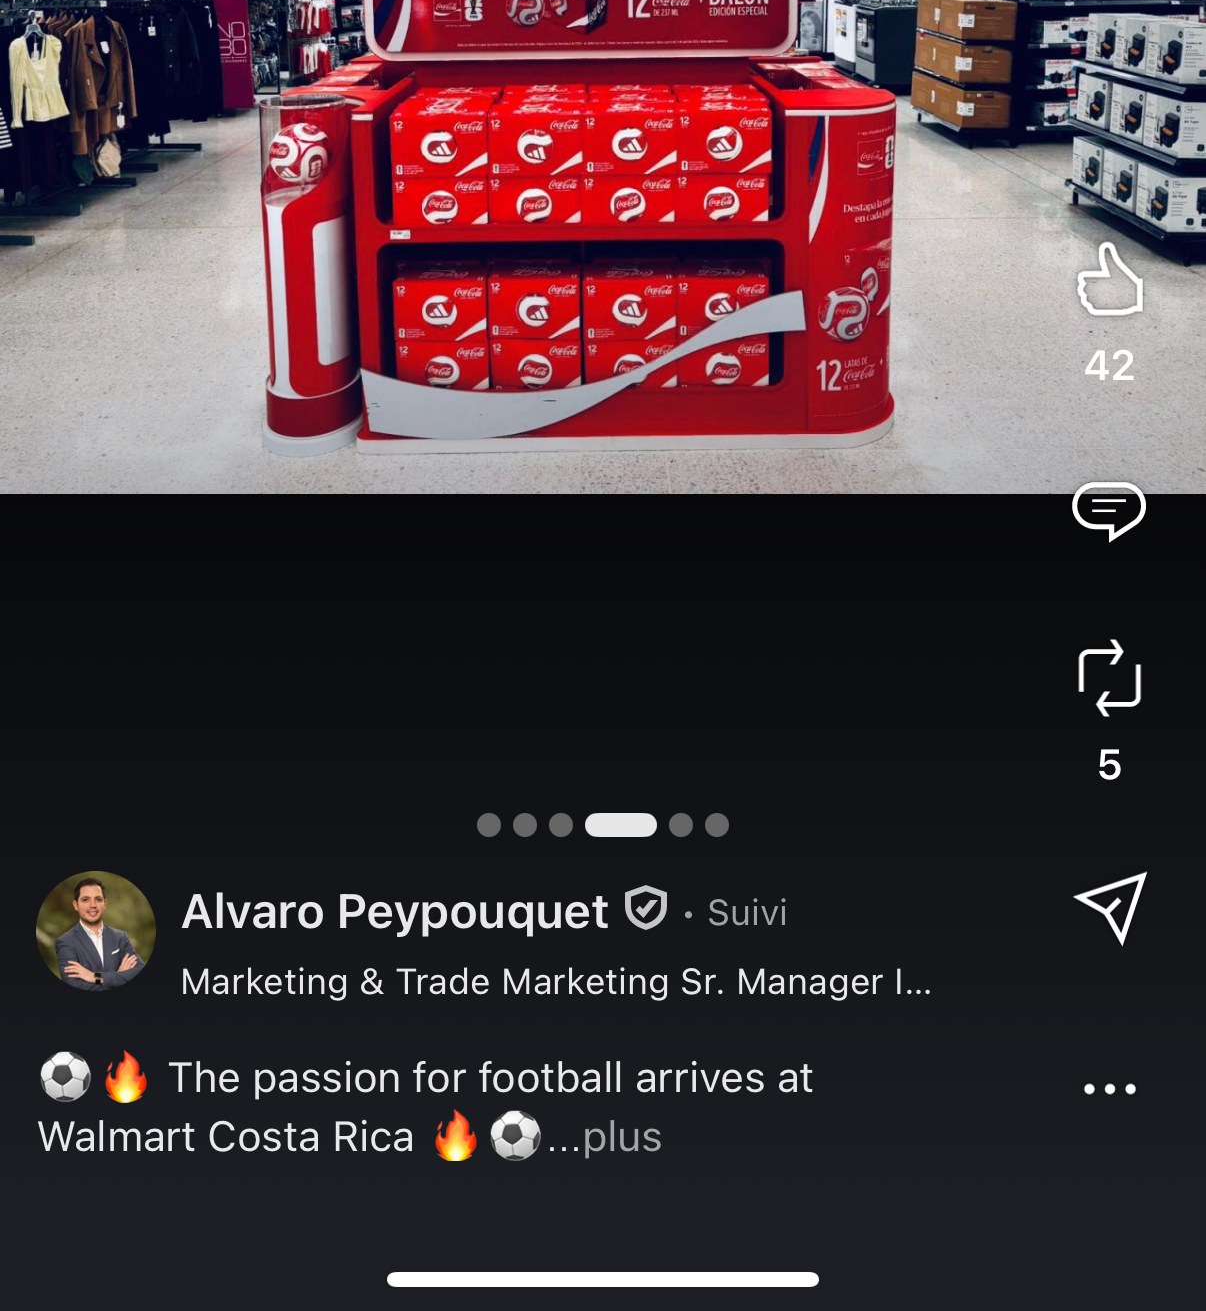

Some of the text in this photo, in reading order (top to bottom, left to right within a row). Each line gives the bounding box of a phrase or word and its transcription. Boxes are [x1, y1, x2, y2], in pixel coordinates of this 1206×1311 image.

[709, 6, 768, 17] EDICIÓN ESPECIAL
[393, 120, 404, 129] 12
[490, 119, 500, 128] 12
[585, 117, 595, 126] 12
[680, 116, 690, 125] 12
[490, 179, 500, 188] 12
[584, 178, 594, 186] 12
[677, 176, 687, 185] 12
[395, 182, 405, 191] 12
[396, 285, 406, 294] 12
[490, 282, 500, 291] 12
[586, 285, 596, 293] 12
[679, 282, 688, 291] 12
[399, 345, 408, 354] 12
[492, 343, 502, 352] 12
[588, 344, 597, 353] 12
[816, 359, 842, 392] 12
